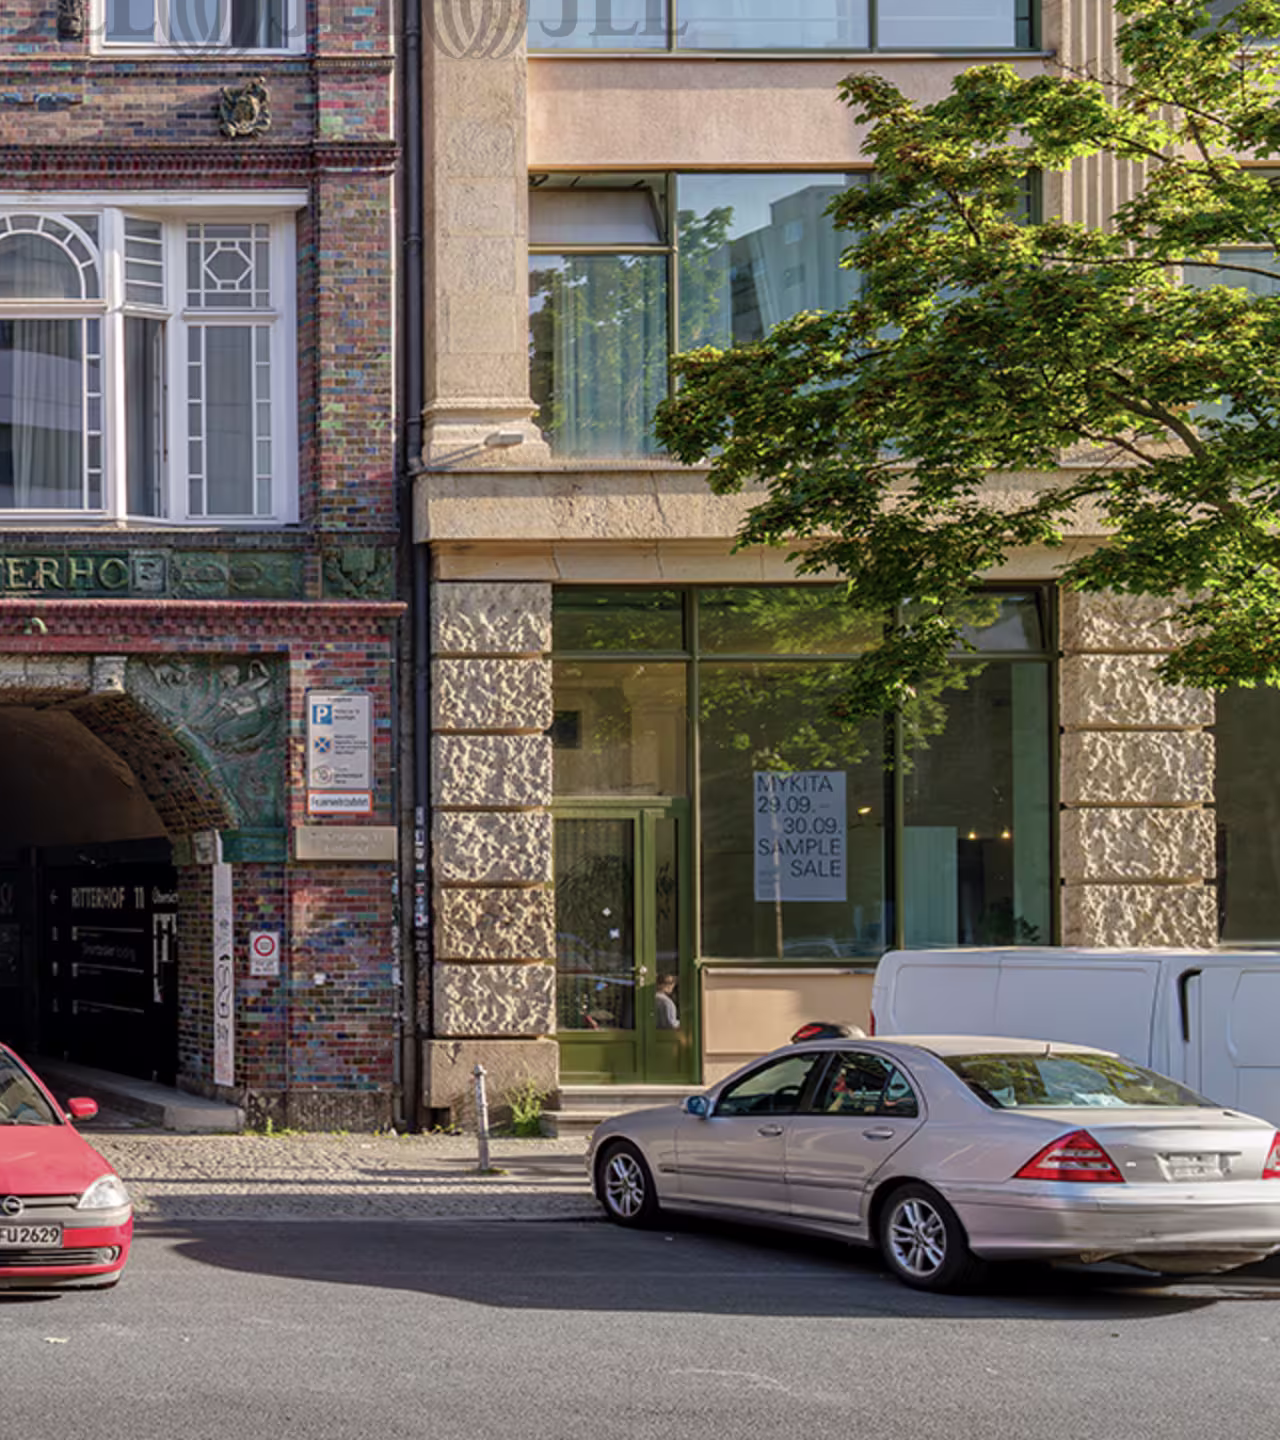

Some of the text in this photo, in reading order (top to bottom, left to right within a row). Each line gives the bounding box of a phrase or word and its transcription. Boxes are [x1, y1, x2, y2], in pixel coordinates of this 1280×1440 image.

[757, 775, 833, 793] MYKITA
[757, 796, 816, 814] 29.09.
[783, 817, 842, 835] 30.09.
[758, 838, 841, 857] SAMPLE
[790, 860, 841, 878] SALE
